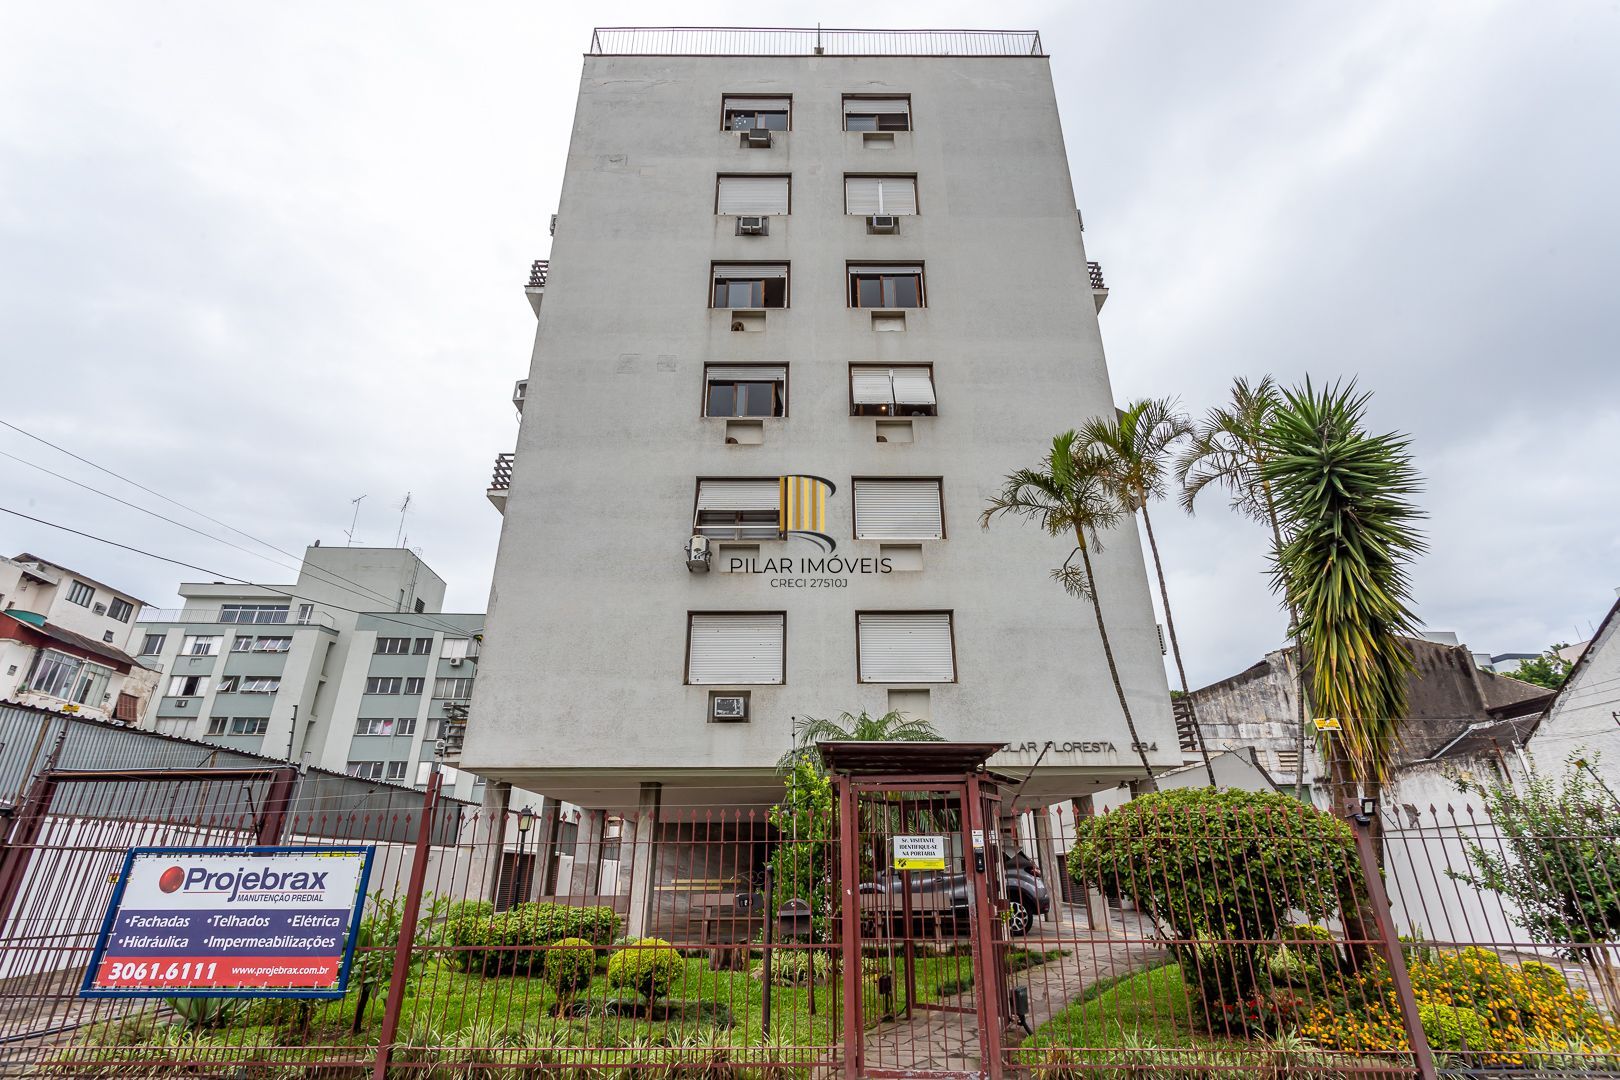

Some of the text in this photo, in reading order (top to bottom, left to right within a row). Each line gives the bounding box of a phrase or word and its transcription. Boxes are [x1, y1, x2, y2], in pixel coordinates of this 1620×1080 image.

[1000, 741, 1038, 753] OLAR
[183, 866, 328, 902] Projebrax
[237, 893, 324, 904] MANUTENÇÃO PREDIAL
[129, 914, 340, 928] Fachadas Telhados Elétrica
[122, 935, 336, 950] Hidráulica Impermeabilizações
[107, 962, 330, 980] 3061.6111 www.projebrax.com.br
